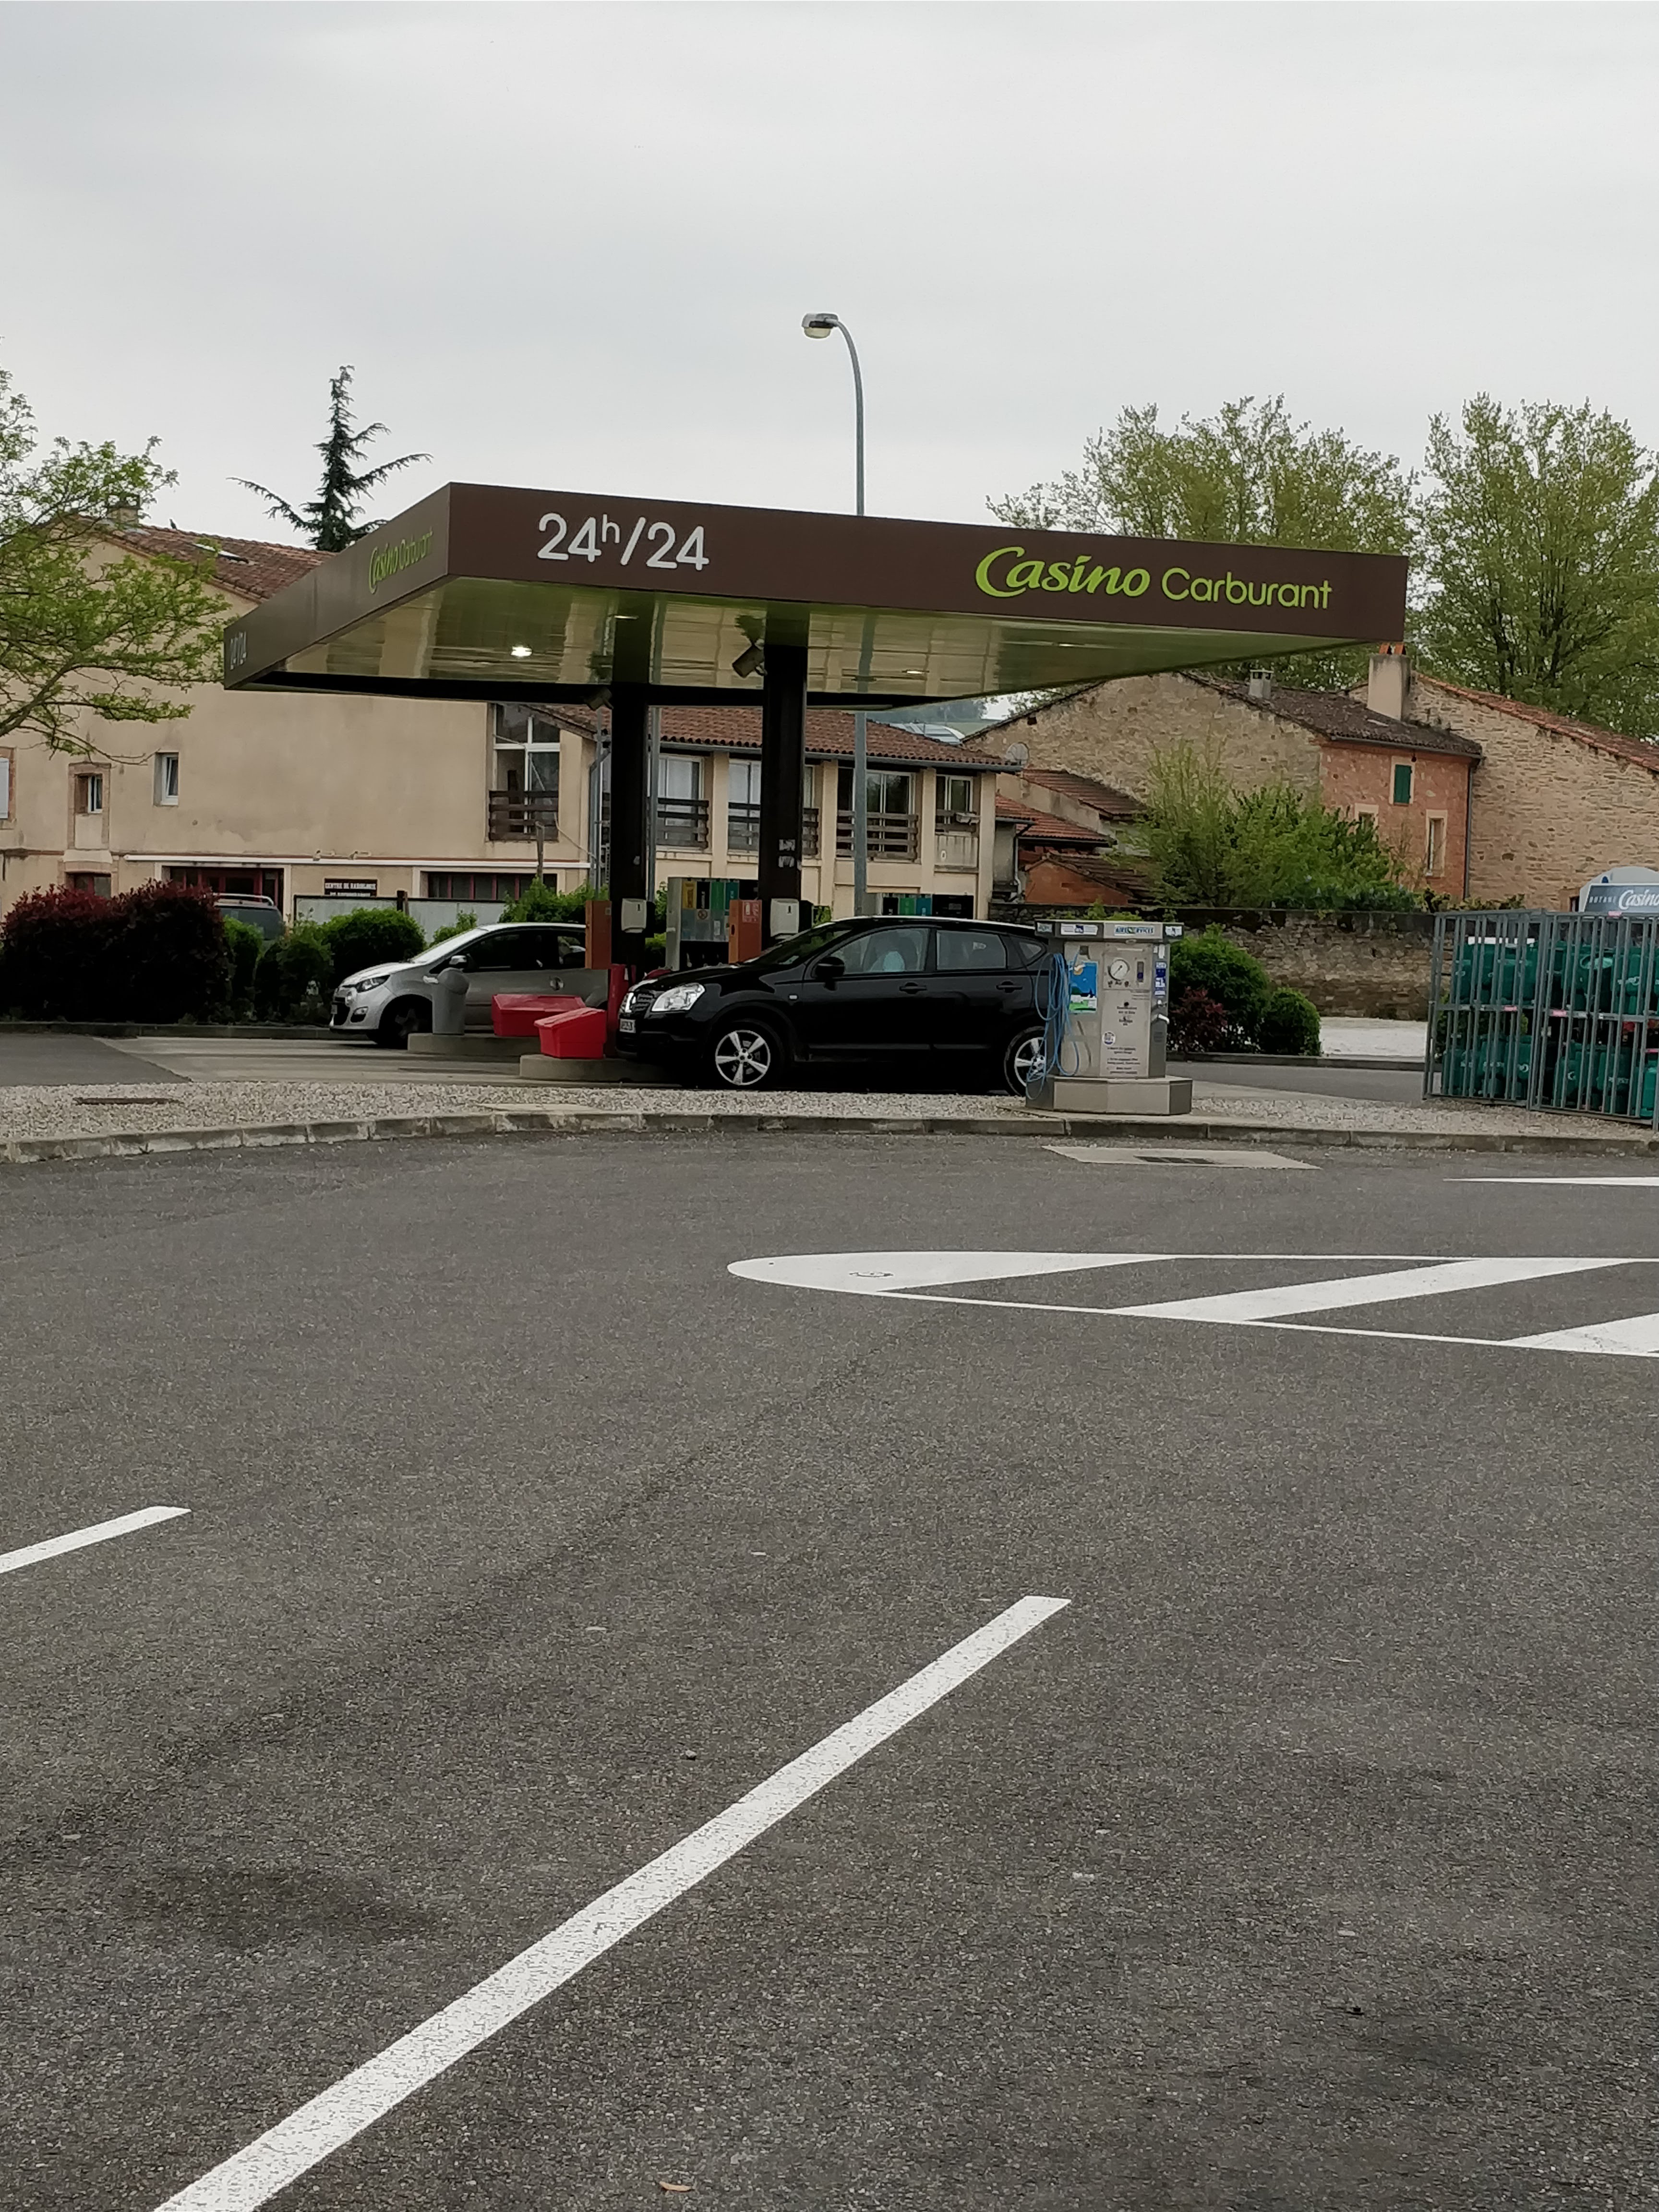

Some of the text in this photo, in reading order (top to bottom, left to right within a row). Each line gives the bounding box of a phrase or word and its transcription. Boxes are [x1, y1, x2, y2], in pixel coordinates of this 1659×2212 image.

[537, 512, 710, 570] 24h/24
[975, 546, 1332, 609] Casino Carburant
